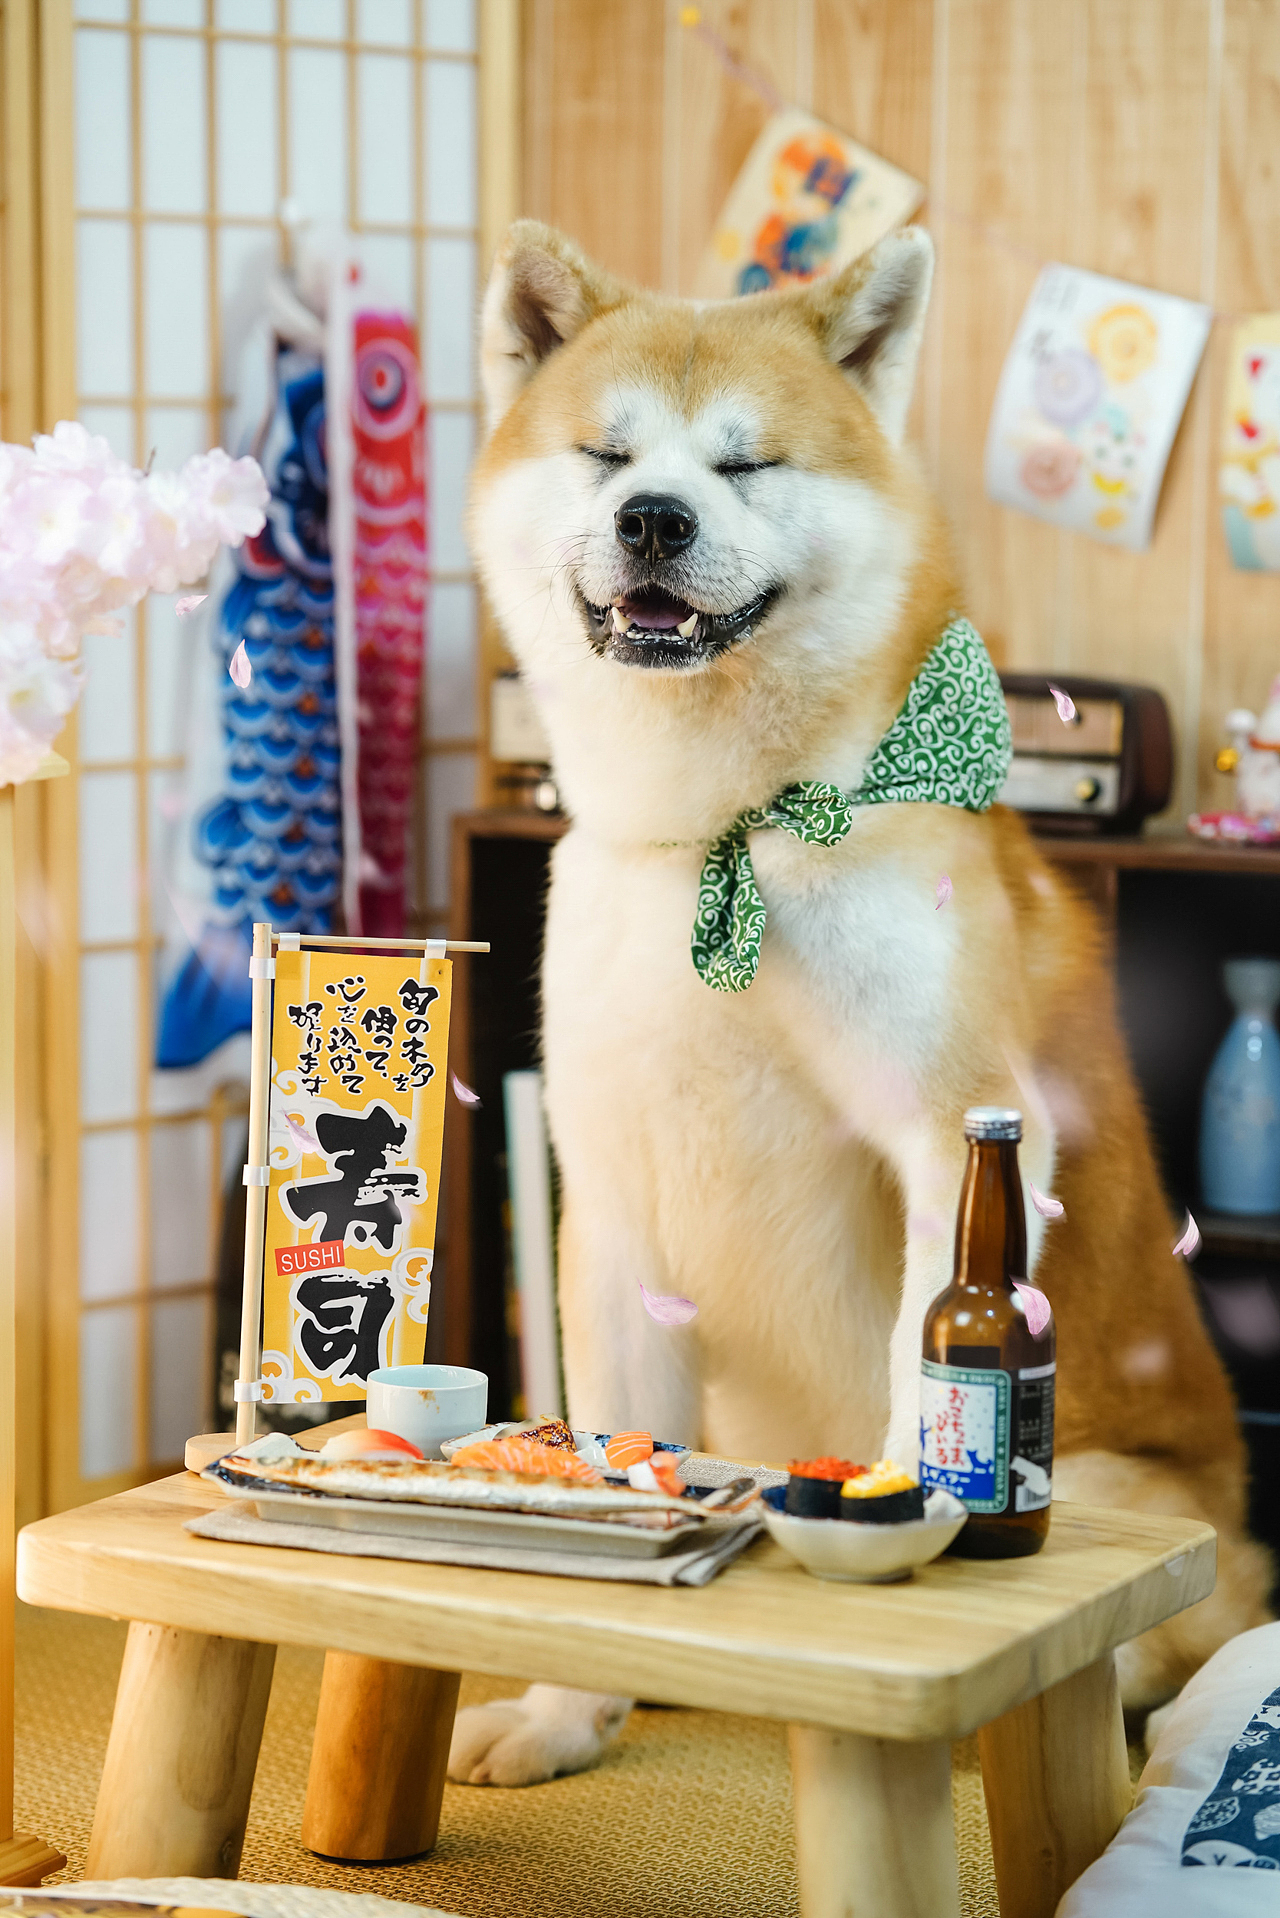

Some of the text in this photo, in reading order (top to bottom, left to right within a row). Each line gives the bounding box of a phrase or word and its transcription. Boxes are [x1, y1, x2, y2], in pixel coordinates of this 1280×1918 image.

[288, 1002, 328, 1097] 握ります
[326, 976, 366, 1094] 心を込めて
[280, 1244, 342, 1274] SUSHI
[286, 1105, 422, 1382] 寿司
